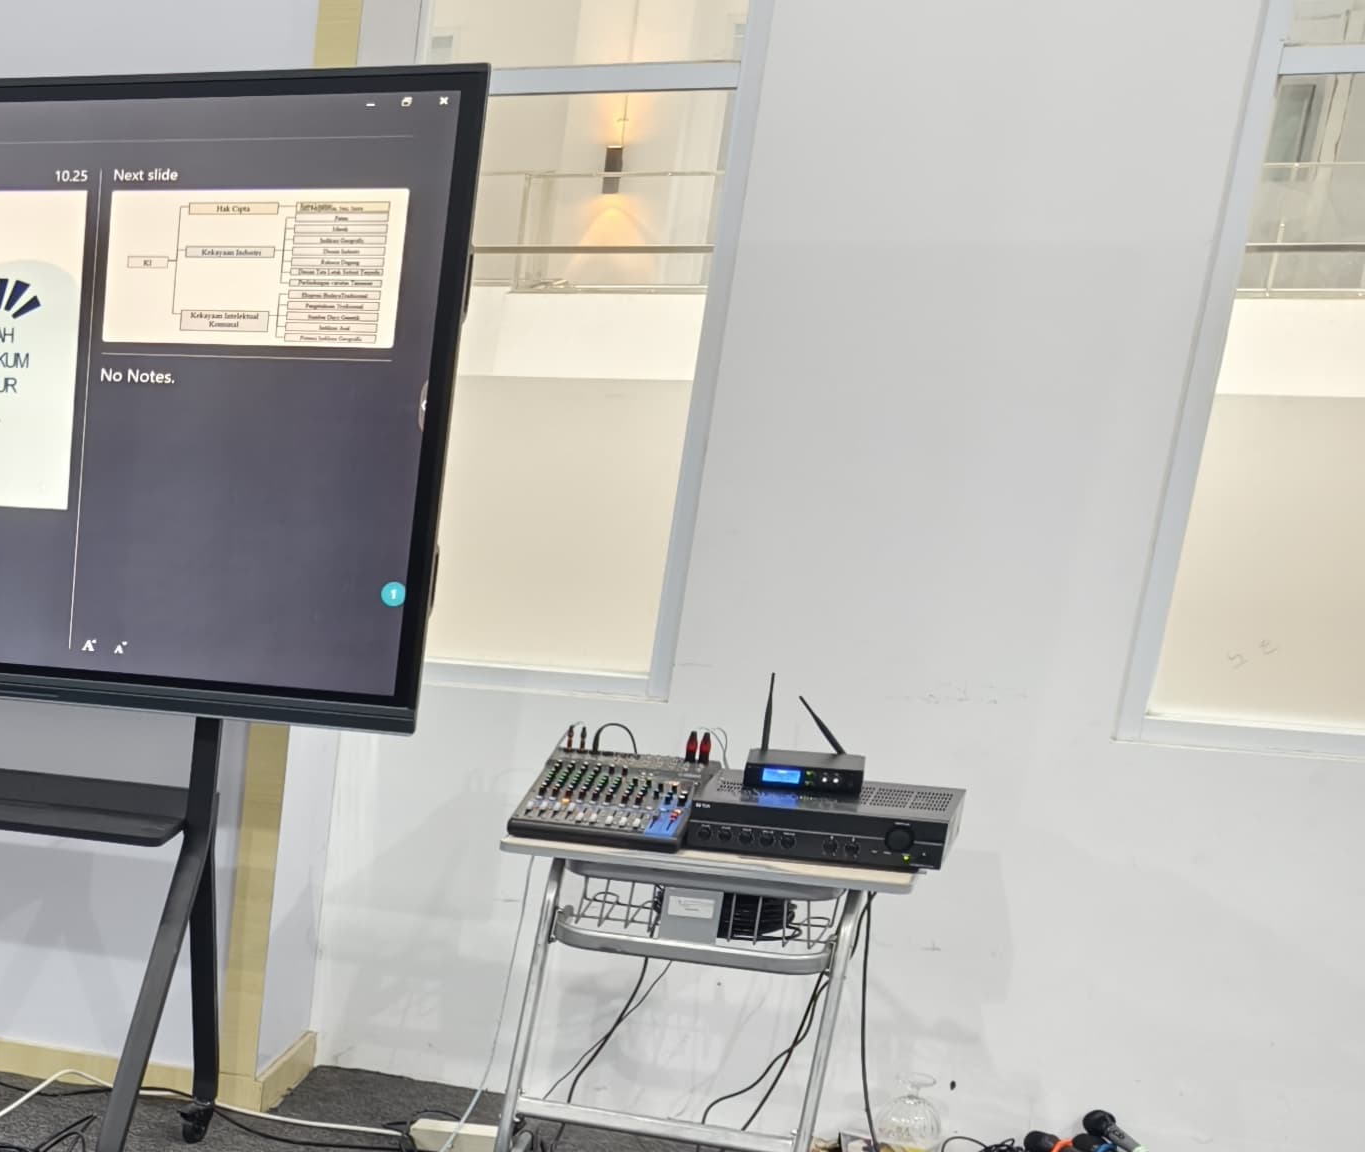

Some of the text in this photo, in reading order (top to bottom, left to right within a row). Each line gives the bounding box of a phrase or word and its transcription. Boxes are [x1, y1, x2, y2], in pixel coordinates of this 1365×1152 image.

[55, 169, 88, 182] 10.25
[113, 167, 178, 182] Next slide
[100, 367, 175, 384] No Notes.
